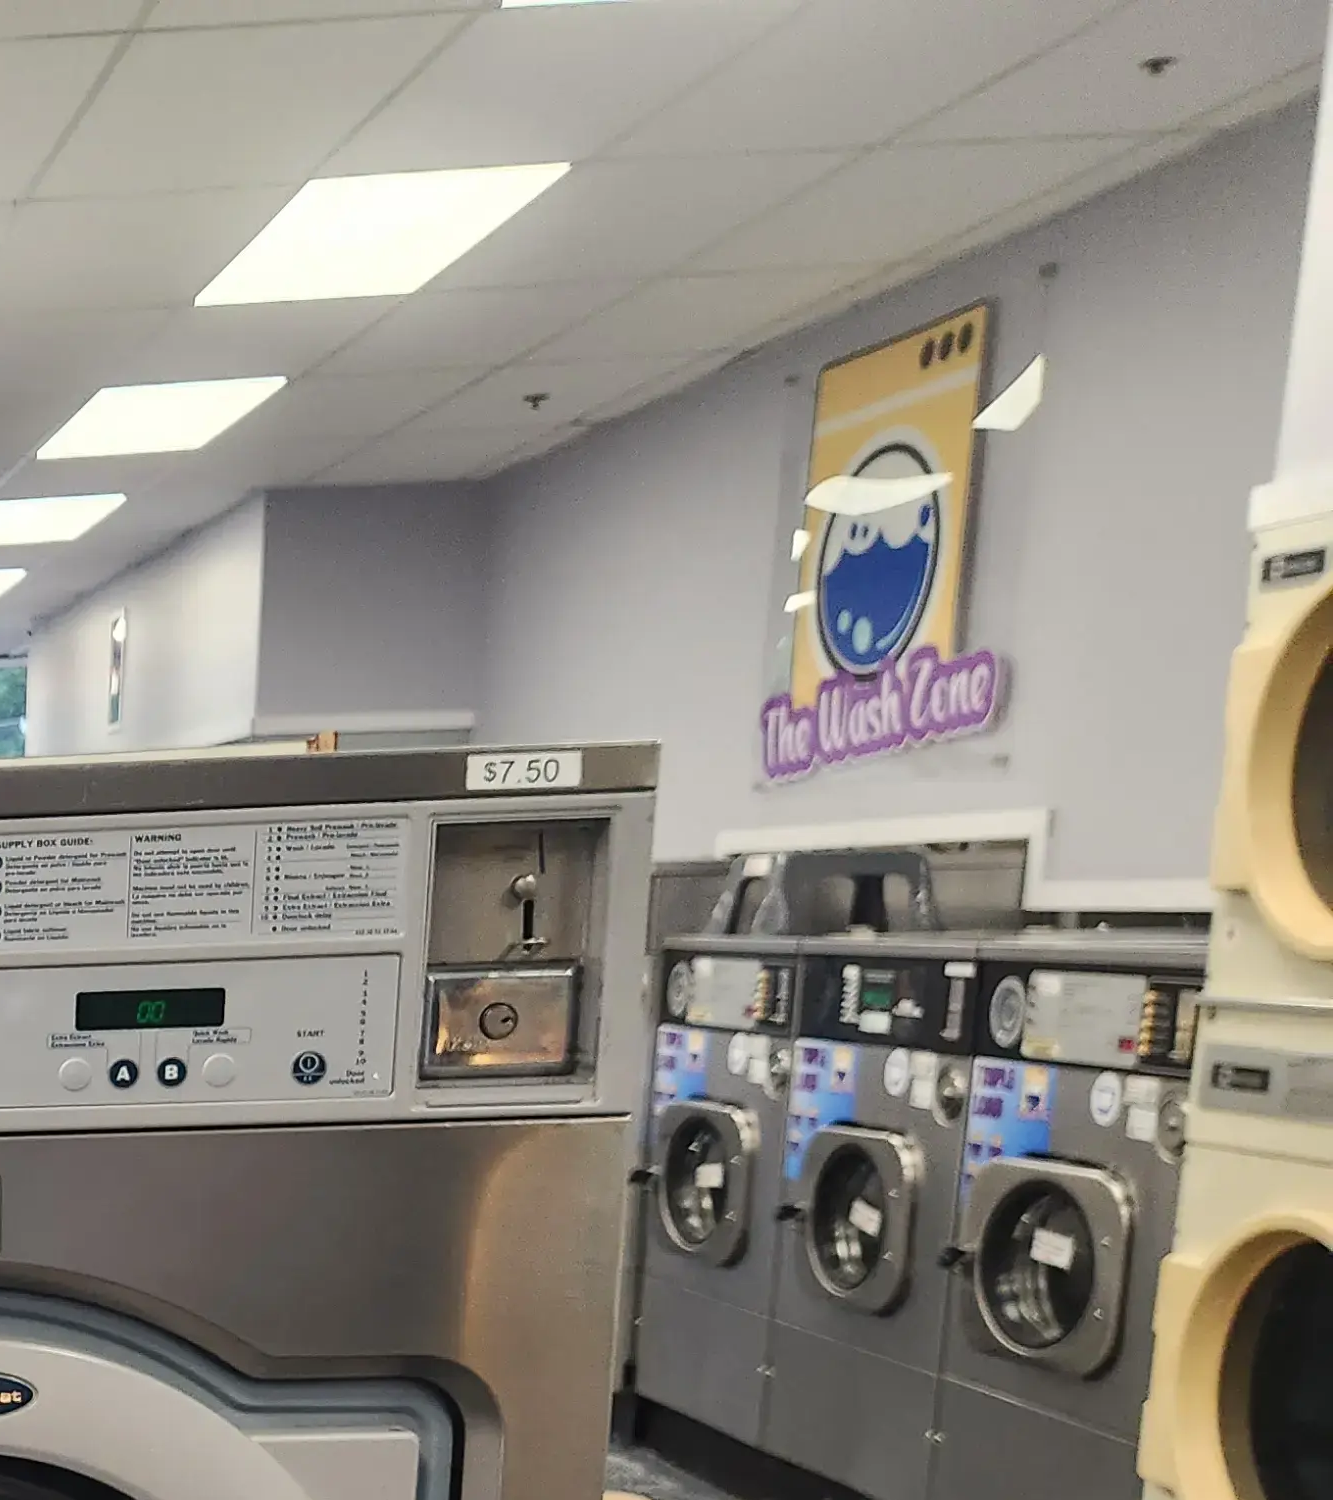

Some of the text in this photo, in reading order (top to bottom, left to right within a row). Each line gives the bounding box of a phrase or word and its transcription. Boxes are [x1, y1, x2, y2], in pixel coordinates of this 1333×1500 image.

[764, 659, 990, 767] The Wash Zone
[483, 758, 560, 783] $7.50
[37, 839, 56, 847] BOX
[135, 834, 182, 843] WARNING
[136, 1000, 166, 1022] 00
[116, 1065, 130, 1081] A
[165, 1064, 178, 1080] B
